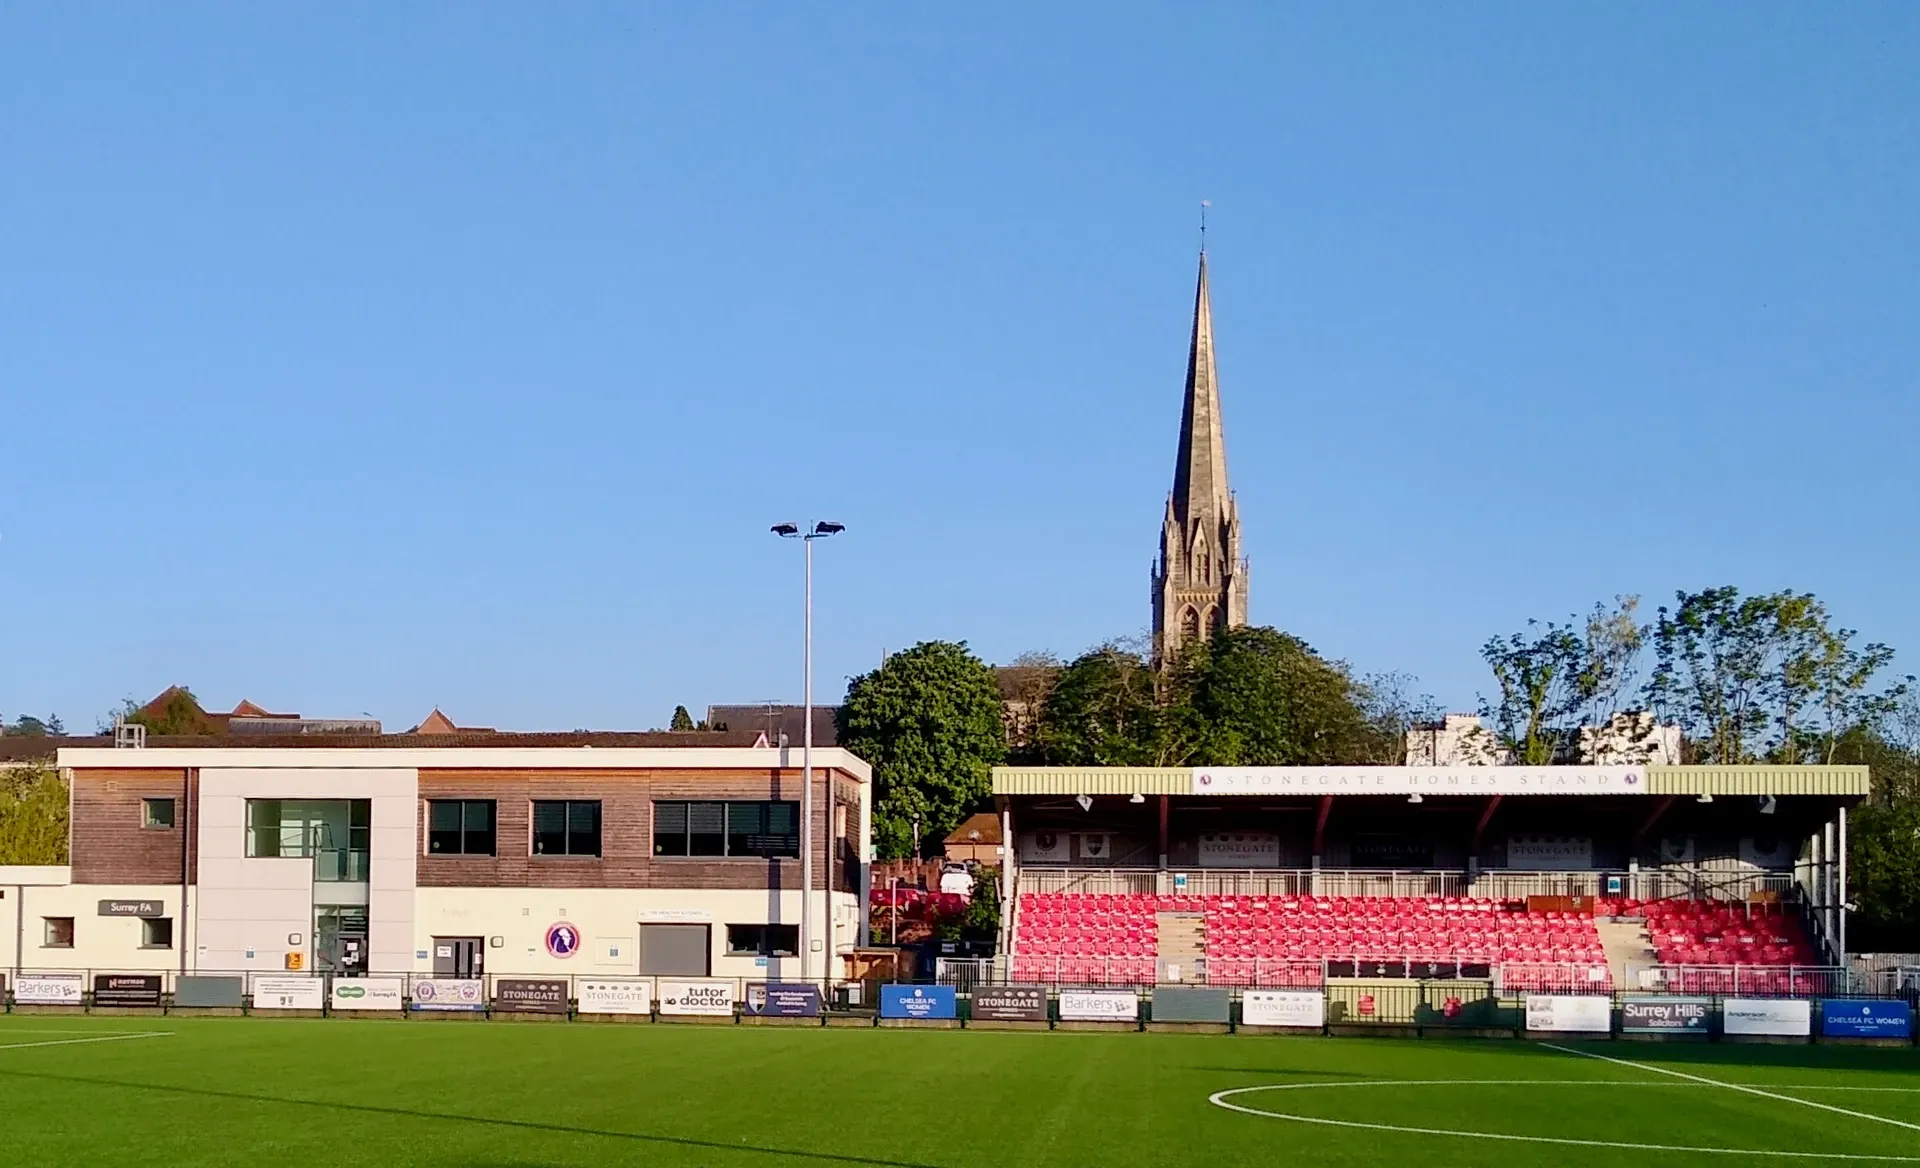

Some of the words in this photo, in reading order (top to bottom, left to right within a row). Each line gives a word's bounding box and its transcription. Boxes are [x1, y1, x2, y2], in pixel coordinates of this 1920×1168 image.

[1226, 775, 1385, 785] STONEGATE
[1408, 775, 1496, 785] HOMES
[1519, 775, 1608, 785] STAND
[110, 902, 138, 913] Surrey
[140, 903, 152, 911] FA
[18, 980, 61, 994] Barkers
[688, 987, 726, 997] tutor
[503, 990, 560, 1000] STONEGATE
[586, 992, 643, 1001] STONEGATE
[680, 995, 731, 1006] doctor
[978, 998, 1039, 1007] STONEGATE
[1064, 995, 1112, 1009] Barkers
[1252, 1003, 1313, 1012] STONEGATE
[1625, 1003, 1671, 1017] Surrey
[1674, 1003, 1705, 1017] Hills
[1648, 1018, 1683, 1027] Solicitors
[1828, 1016, 1862, 1024] CHELSEA
[1875, 1017, 1905, 1025] WOMEN
